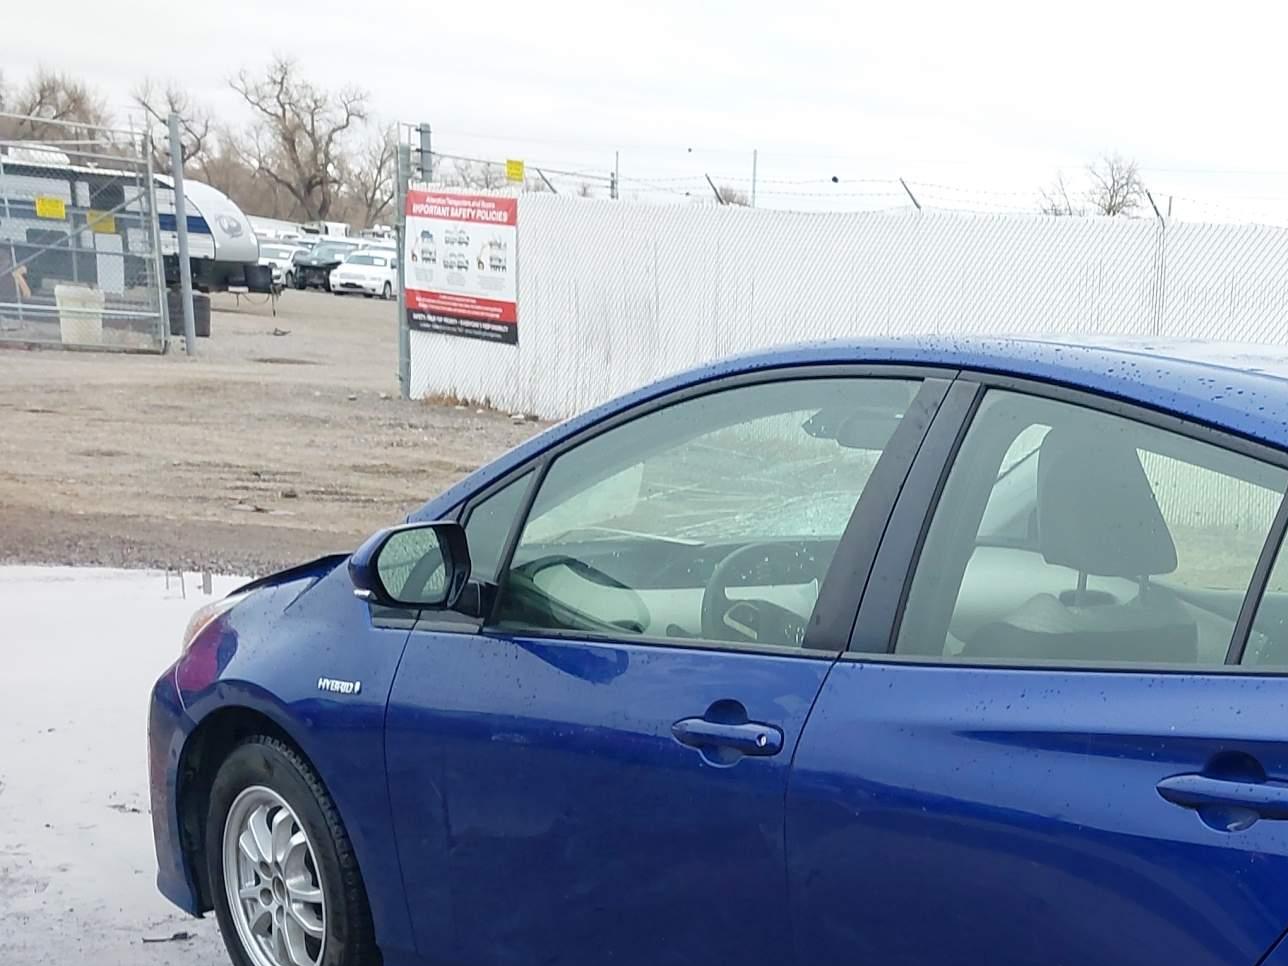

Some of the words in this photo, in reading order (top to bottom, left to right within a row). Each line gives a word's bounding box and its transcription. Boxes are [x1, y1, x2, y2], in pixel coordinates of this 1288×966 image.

[412, 203, 449, 217] IMPORTANT
[450, 206, 476, 220] SAFETY
[476, 208, 508, 222] POLICIES
[317, 677, 354, 694] HYBRID
